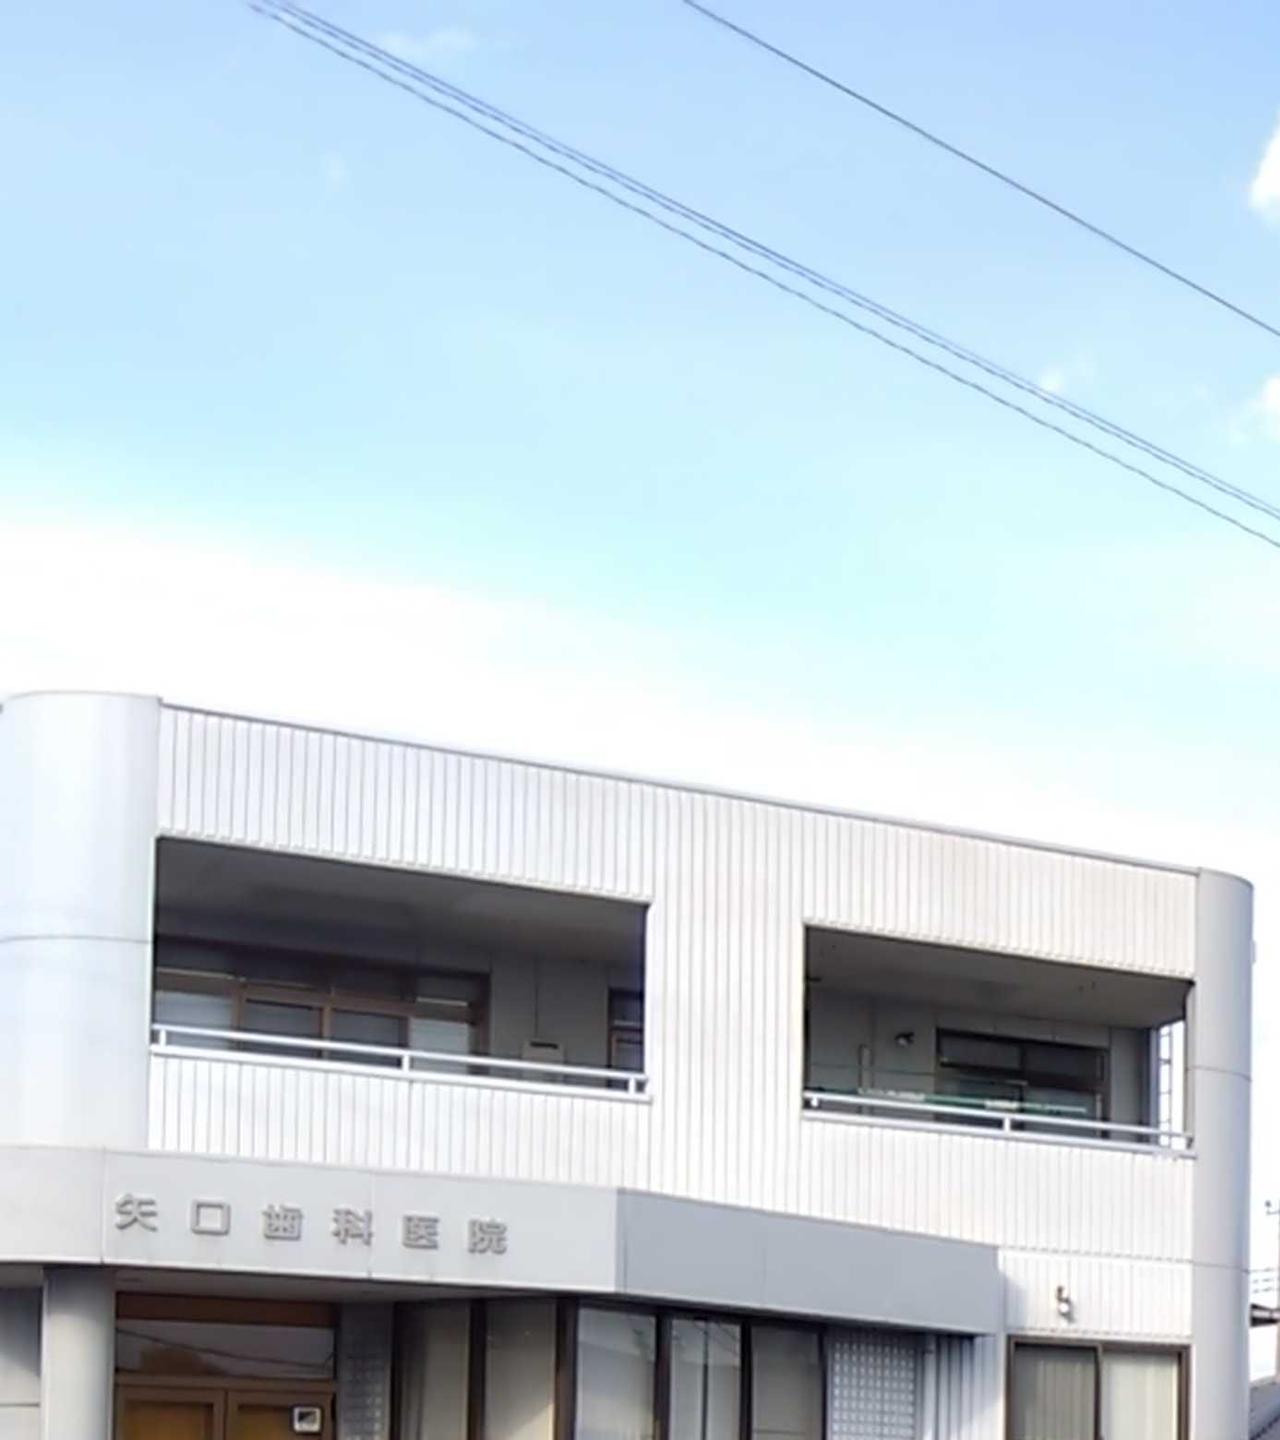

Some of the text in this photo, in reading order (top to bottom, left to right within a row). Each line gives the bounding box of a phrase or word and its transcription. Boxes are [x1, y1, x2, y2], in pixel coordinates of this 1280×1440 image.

[115, 1193, 508, 1256] 矢口歯科医院
